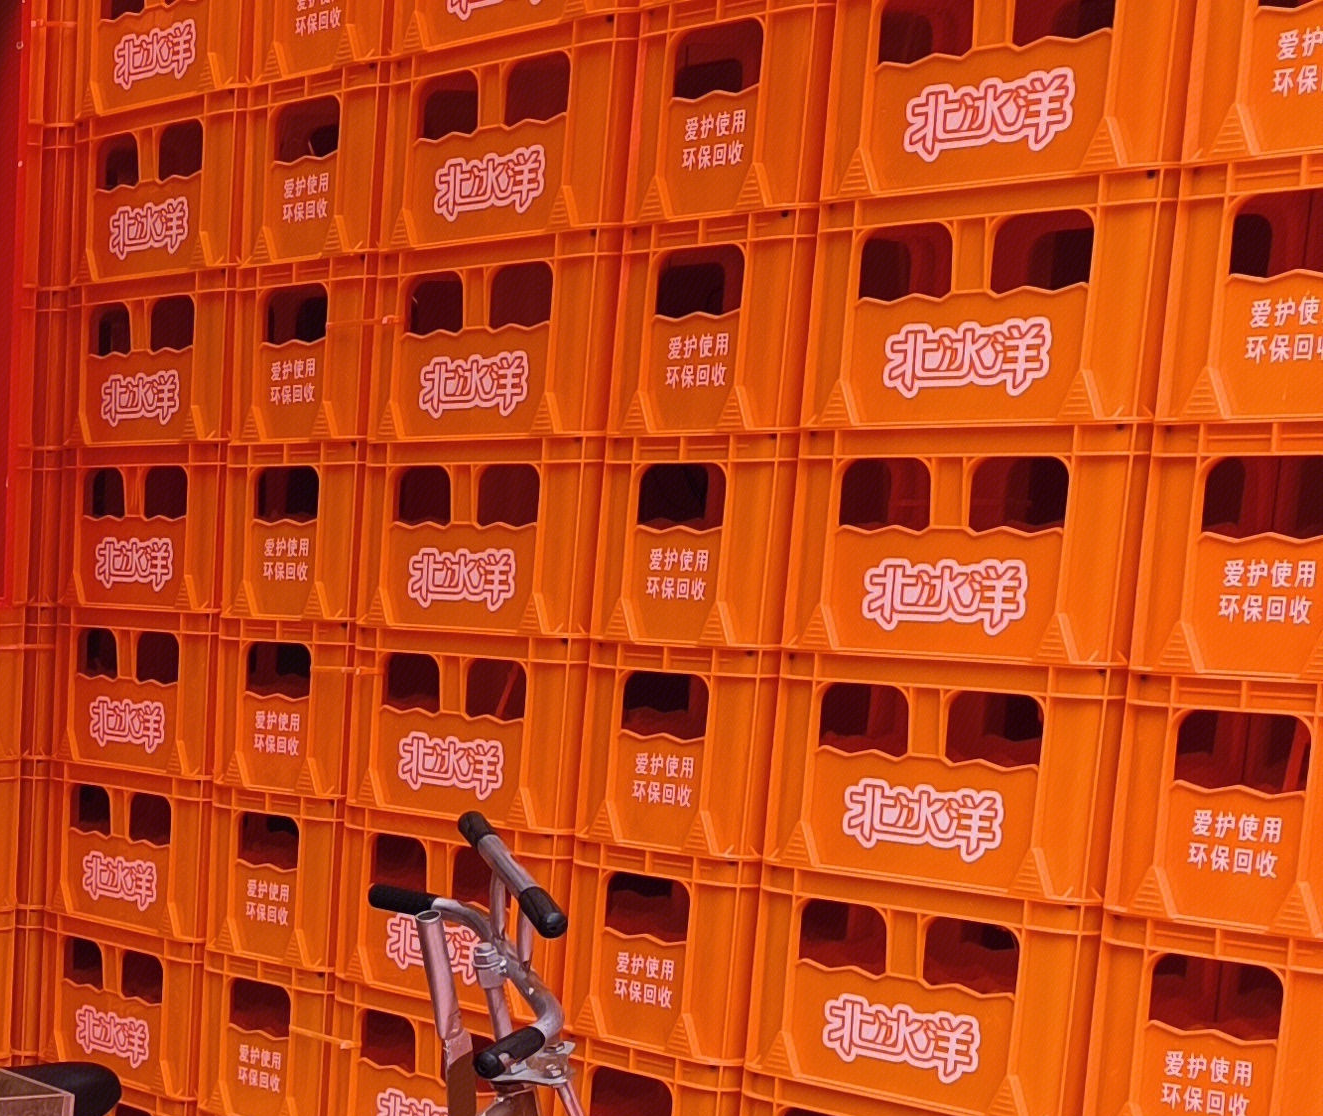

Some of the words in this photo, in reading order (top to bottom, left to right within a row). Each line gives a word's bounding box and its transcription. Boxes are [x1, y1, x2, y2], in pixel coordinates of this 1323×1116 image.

[114, 20, 196, 89] 北冰洋
[1271, 65, 1323, 98] 环保
[683, 109, 745, 141] 爱护使用
[903, 68, 1075, 162] 北冰洋
[681, 141, 742, 169] 环保回收
[283, 173, 329, 199] 爱护使用
[434, 145, 545, 221] 北冰洋
[282, 199, 327, 221] 环保回收
[110, 197, 188, 260] 北冰洋
[1249, 290, 1323, 329] 爱护使
[666, 332, 729, 360] 爱护使用
[883, 317, 1052, 398] 北冰洋
[270, 358, 316, 381] 爱护使用
[419, 351, 528, 418] 北冰洋
[665, 363, 726, 388] 环保回收
[101, 370, 179, 427] 北冰洋
[271, 383, 315, 404] 环保回收
[264, 537, 309, 557] 爱护使用
[649, 548, 709, 572] 爱护使用
[96, 537, 173, 591] 北冰洋
[262, 562, 308, 581] 环保回收
[408, 548, 515, 611] 北冰洋
[1222, 560, 1316, 588] 爱护使用
[646, 577, 705, 601] 环保回收
[862, 559, 1028, 636] 北冰洋
[1217, 594, 1311, 625] 环保回收
[90, 697, 165, 753] 北冰洋
[255, 711, 300, 732] 爱护使用
[252, 734, 300, 756] 环保回收
[398, 731, 503, 800] 北冰洋
[634, 753, 694, 778] 爱护使用
[633, 781, 691, 807] 环保回收
[843, 778, 1004, 863] 北冰洋
[1190, 809, 1284, 844] 爱护使用
[1186, 843, 1278, 878] 环保回收
[83, 851, 157, 911] 北冰洋
[246, 879, 289, 902] 爱护使用
[246, 902, 288, 925] 环保回收
[386, 914, 479, 985] 北洋
[616, 952, 675, 982] 爱护使用
[613, 978, 671, 1009] 环保回收
[76, 1005, 149, 1068] 北冰洋
[823, 994, 981, 1084] 北冰洋
[239, 1044, 282, 1071] 爱护使用
[1164, 1051, 1253, 1087] 爱护使用
[238, 1068, 280, 1093] 环保回收
